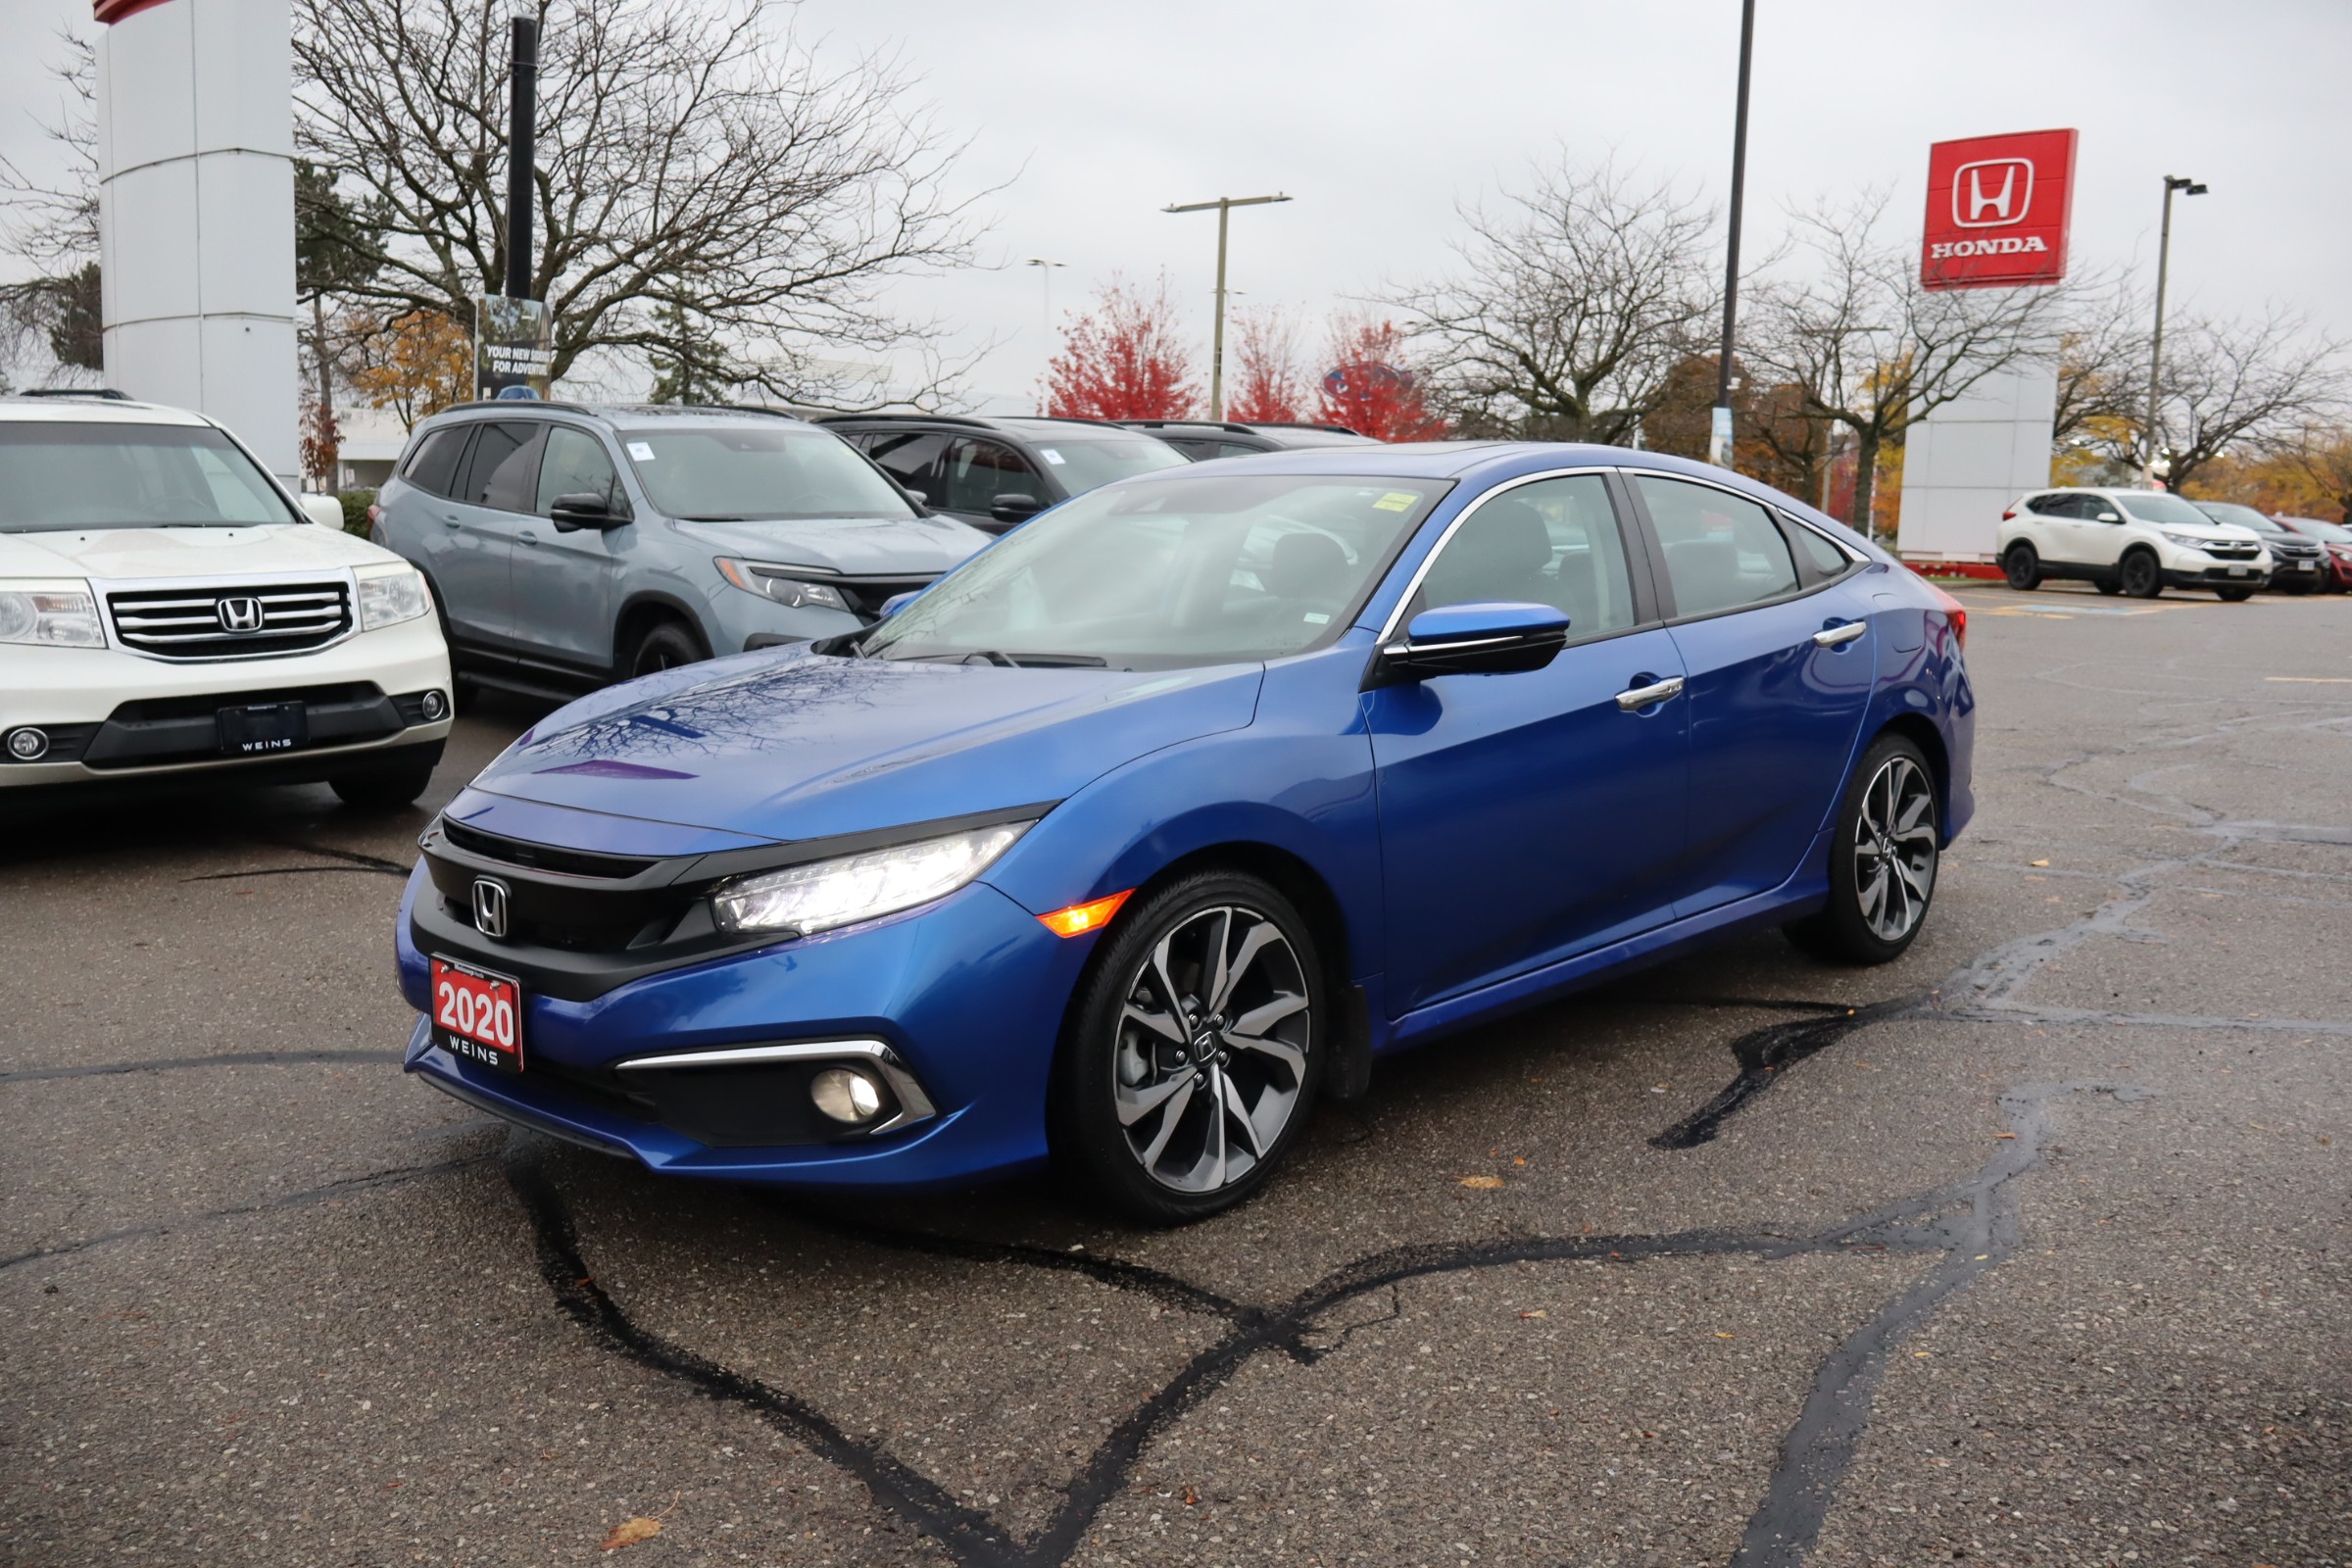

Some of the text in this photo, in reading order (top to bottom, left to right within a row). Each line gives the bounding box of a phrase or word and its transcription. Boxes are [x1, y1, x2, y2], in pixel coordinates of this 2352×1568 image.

[1931, 236, 2048, 259] HONDA
[486, 344, 512, 360] YOUR
[513, 348, 530, 361] NEW
[493, 360, 512, 373] FOR
[242, 739, 292, 752] WEINS
[439, 981, 514, 1047] 2020
[449, 1035, 498, 1065] WEINS
